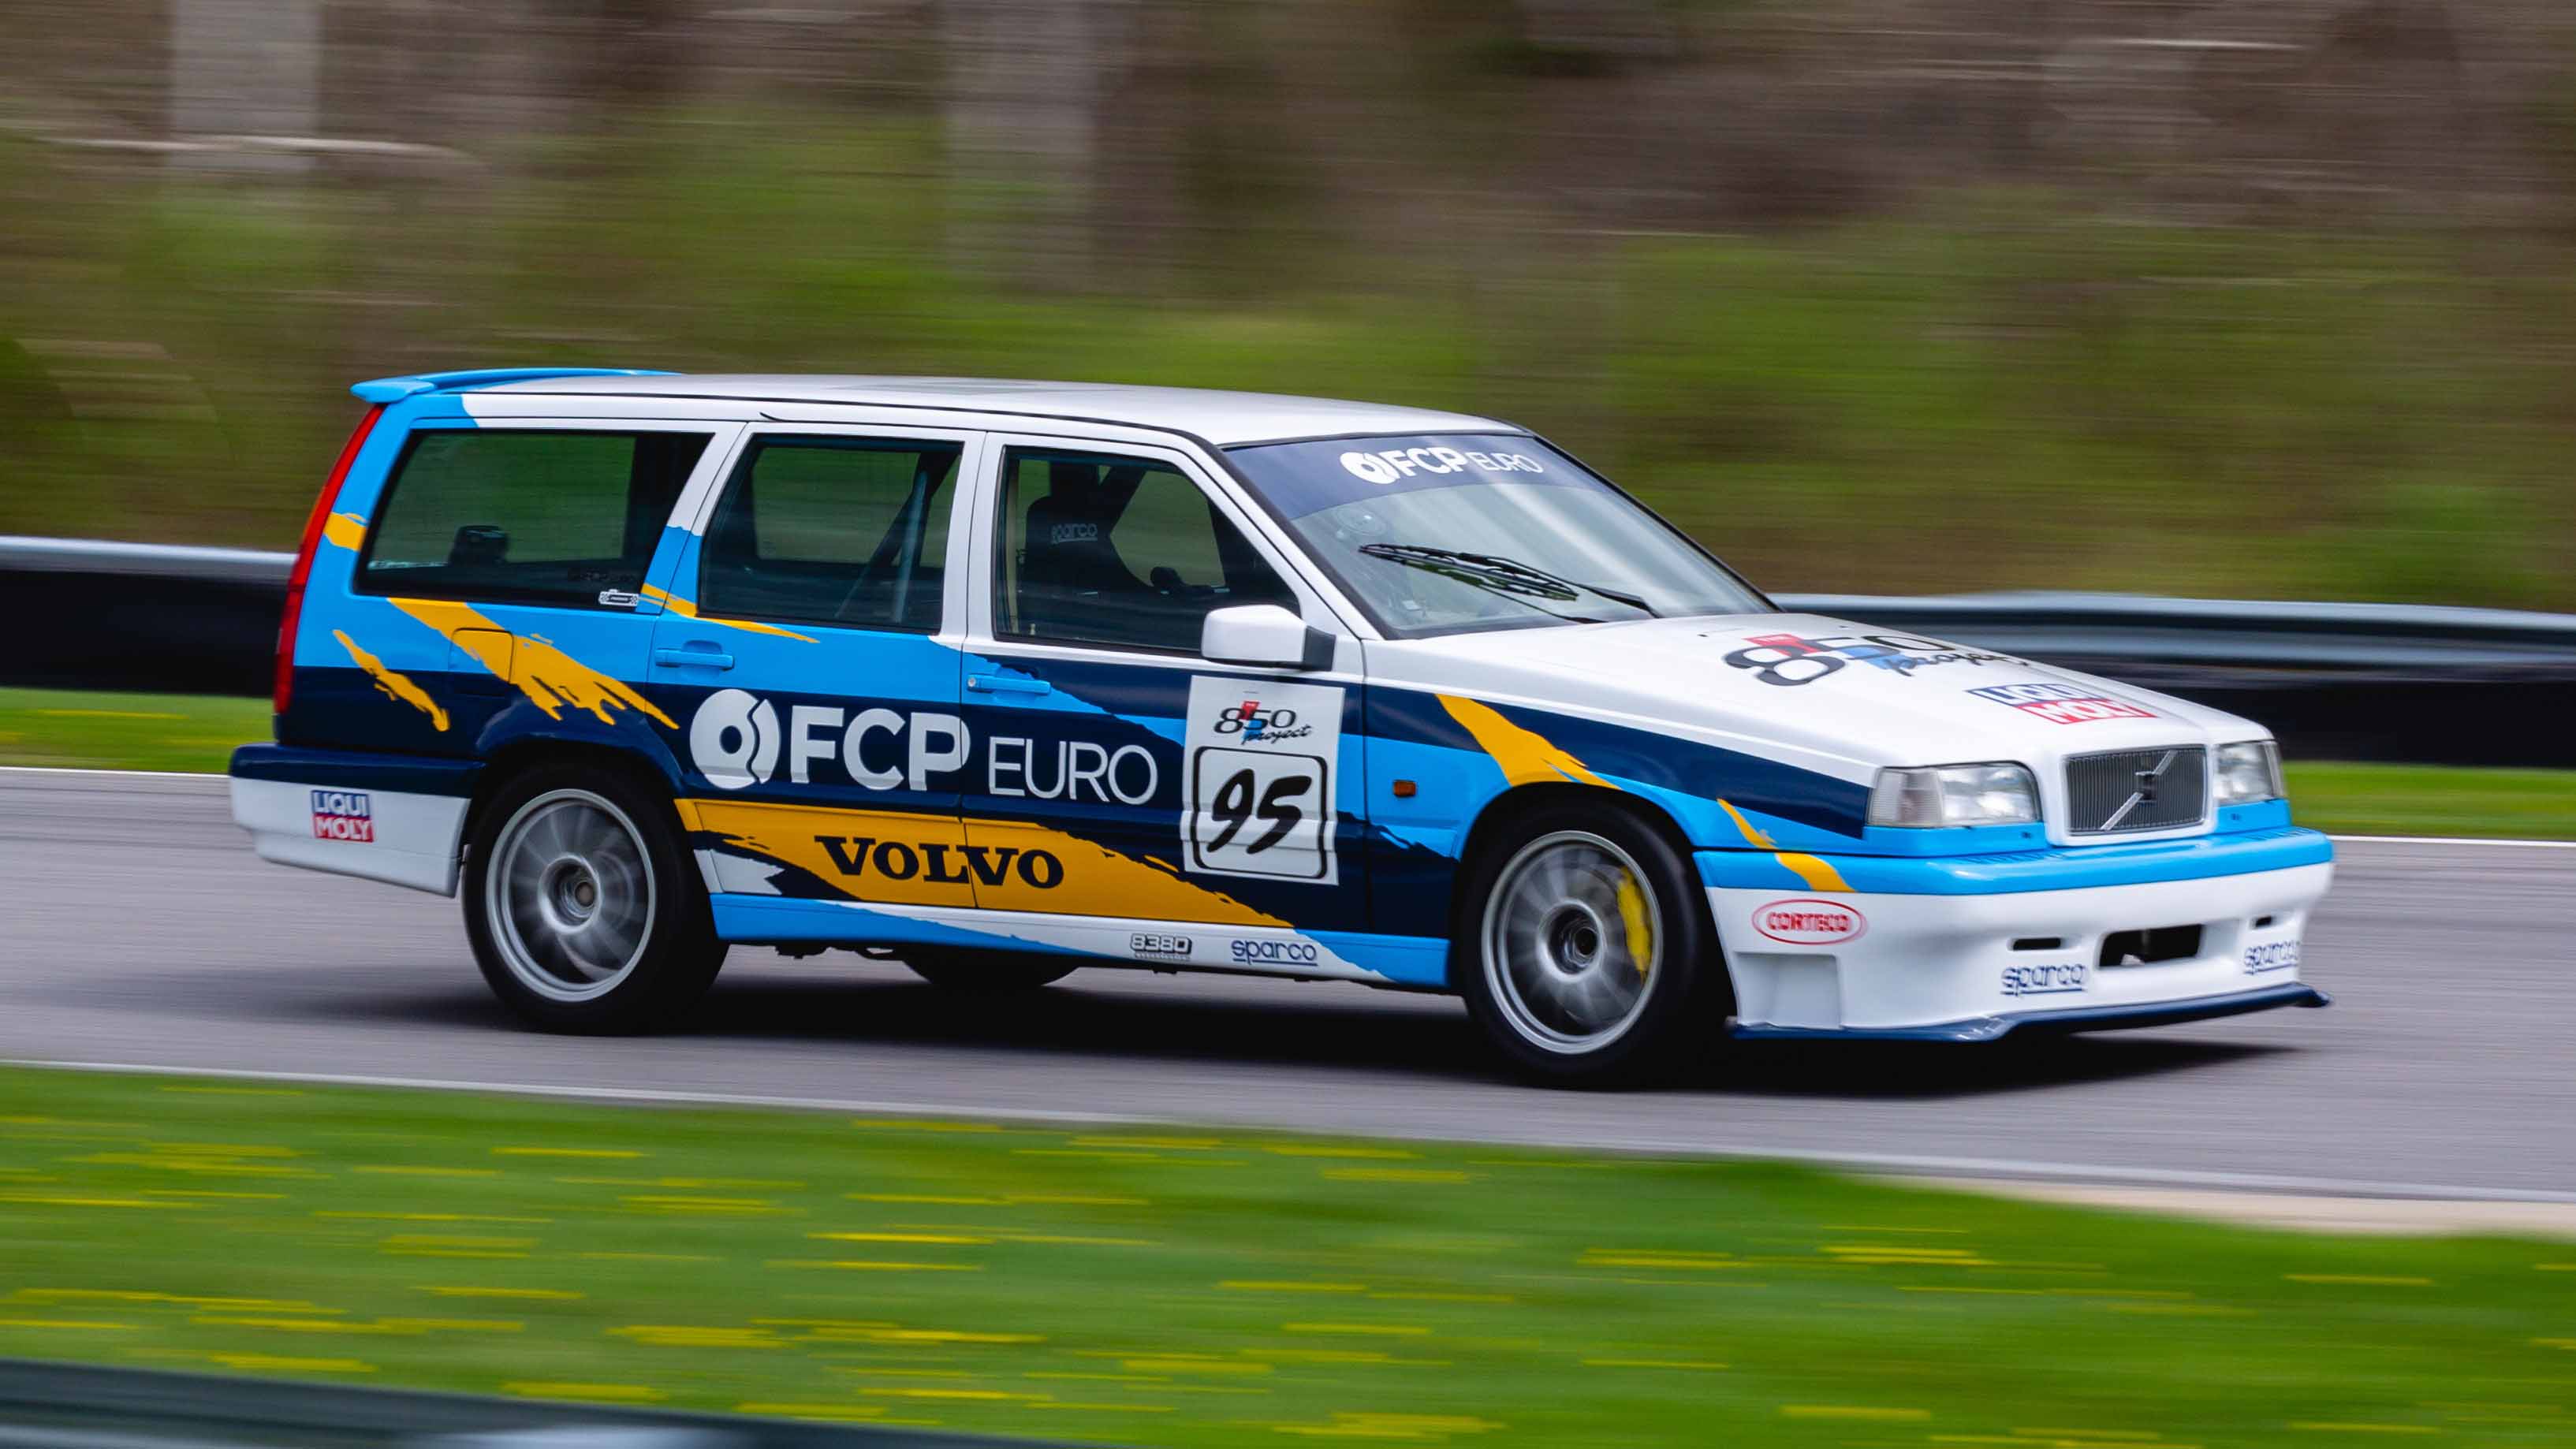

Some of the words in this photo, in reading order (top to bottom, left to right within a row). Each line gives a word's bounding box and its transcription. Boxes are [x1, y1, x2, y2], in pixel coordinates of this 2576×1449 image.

[1377, 447, 1467, 476] FCP
[1464, 451, 1544, 473] EURO
[1724, 634, 1955, 686] 850
[1971, 684, 2101, 706] LIQUI
[1213, 707, 1297, 734] 850
[2020, 700, 2149, 722] MOLY
[1241, 724, 1312, 745] project
[790, 704, 971, 792] FCP
[988, 736, 1158, 806] EURO
[314, 792, 368, 816] LIQUI
[1206, 768, 1312, 855] 95
[315, 815, 373, 841] MOLY
[814, 835, 1064, 889] VOLVO
[1765, 912, 1851, 933] CORTECO
[1230, 938, 1318, 966] sparco
[2000, 963, 2089, 996] sparco
